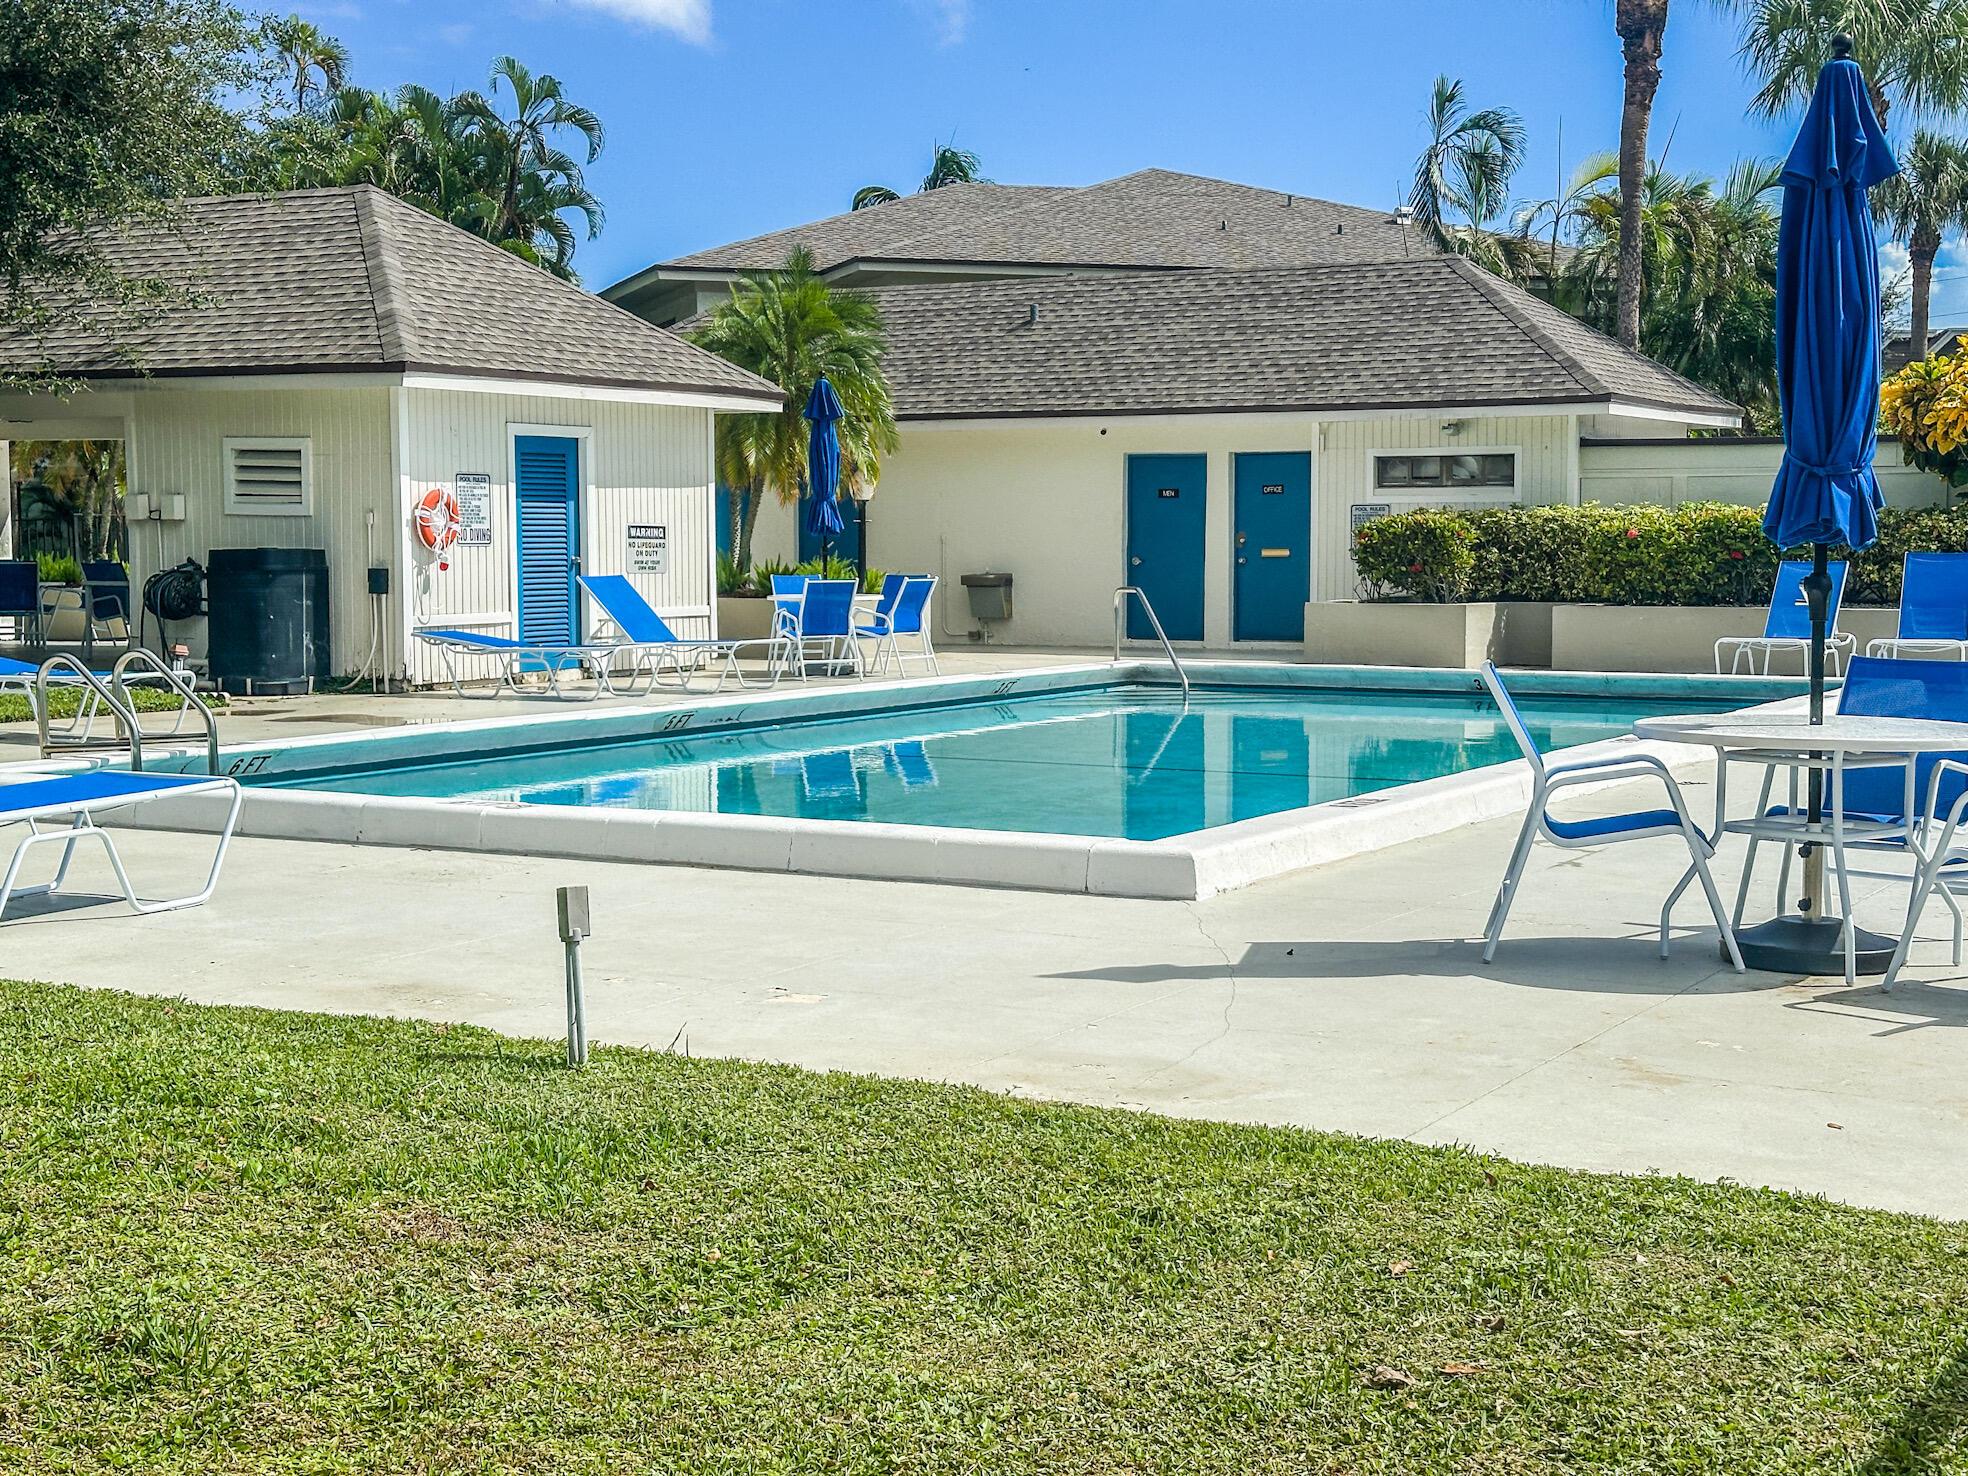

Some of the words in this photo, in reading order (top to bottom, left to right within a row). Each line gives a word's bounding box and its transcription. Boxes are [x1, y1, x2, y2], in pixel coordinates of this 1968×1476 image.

[470, 528, 491, 541] DIVING
[630, 527, 664, 538] WARNING
[628, 541, 636, 549] NO
[637, 541, 666, 549] LIFEGUARD
[1473, 679, 1483, 691] 3
[663, 715, 678, 731] 5
[672, 713, 695, 729] FT
[228, 758, 245, 776] 6
[241, 755, 272, 774] FT
